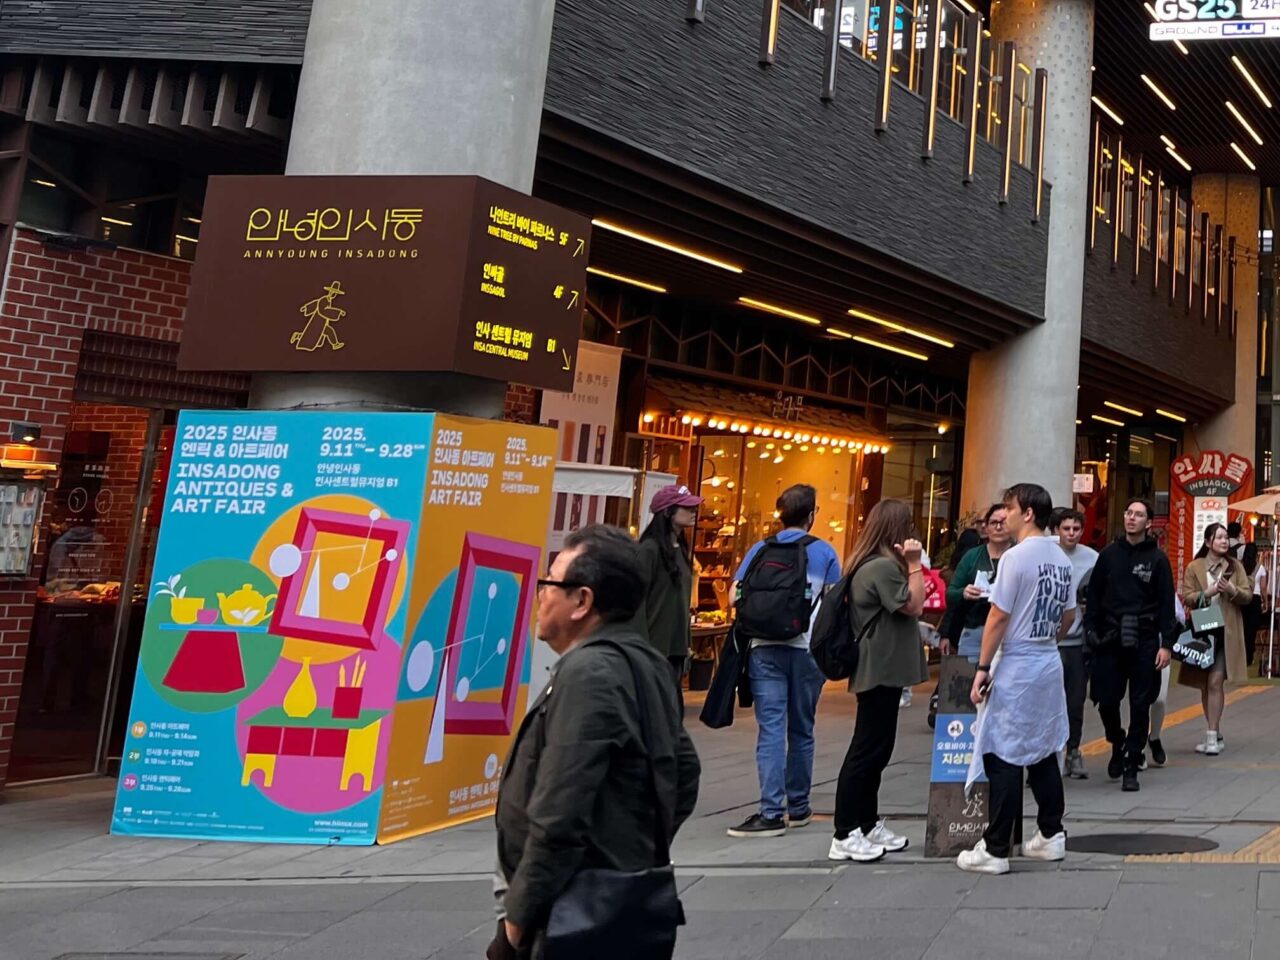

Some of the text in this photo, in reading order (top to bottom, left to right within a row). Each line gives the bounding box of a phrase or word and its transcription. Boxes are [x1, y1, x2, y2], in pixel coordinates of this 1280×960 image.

[246, 208, 423, 241] 안녕인사동
[244, 249, 419, 259] ANNYOUNG INSADONG
[183, 425, 278, 441] 2025 인사동
[322, 427, 367, 441] 2025.
[437, 429, 463, 446] 2025
[213, 443, 226, 458] &
[228, 442, 289, 459] 아트페어
[434, 447, 461, 465] 인사동
[176, 463, 281, 480] INSADONG
[431, 470, 489, 489] INSADONG
[173, 481, 294, 497] ANTIQUES &
[386, 478, 398, 487] B1
[1189, 480, 1232, 491] INSSAGOL
[428, 489, 482, 506] ART FAIR
[1206, 488, 1217, 496] 4F
[170, 498, 266, 514] ART FAIR
[1038, 563, 1057, 580] LOVE
[1037, 577, 1071, 603] TO THE
[1032, 597, 1066, 624] MOO
